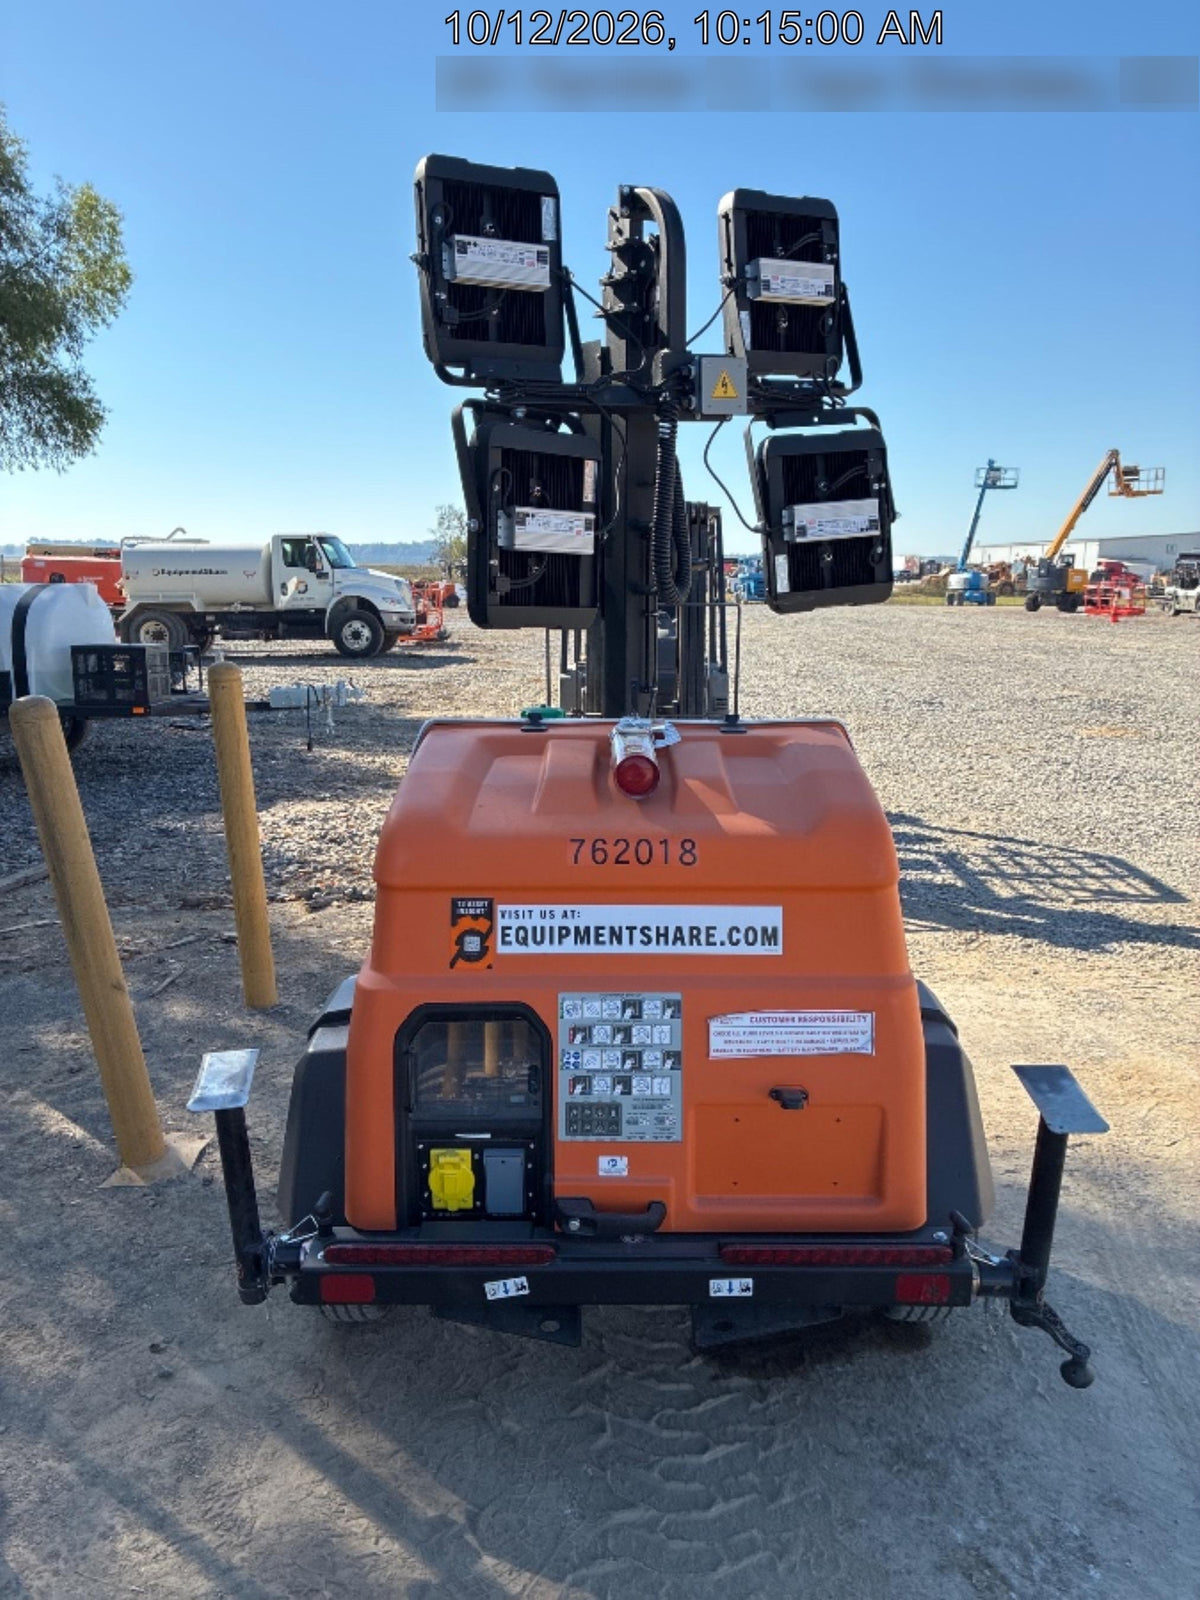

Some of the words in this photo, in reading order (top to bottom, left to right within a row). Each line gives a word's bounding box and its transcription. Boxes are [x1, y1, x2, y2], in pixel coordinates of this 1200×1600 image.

[569, 838, 698, 867] 762018
[499, 909, 534, 920] VISIT
[540, 909, 556, 920] US
[561, 909, 581, 920] AT:
[500, 925, 779, 949] EQUIPMENTSHARE.COM
[749, 1015, 796, 1024] CUSTOMER
[798, 1014, 868, 1024] RESPONSIBILITY
